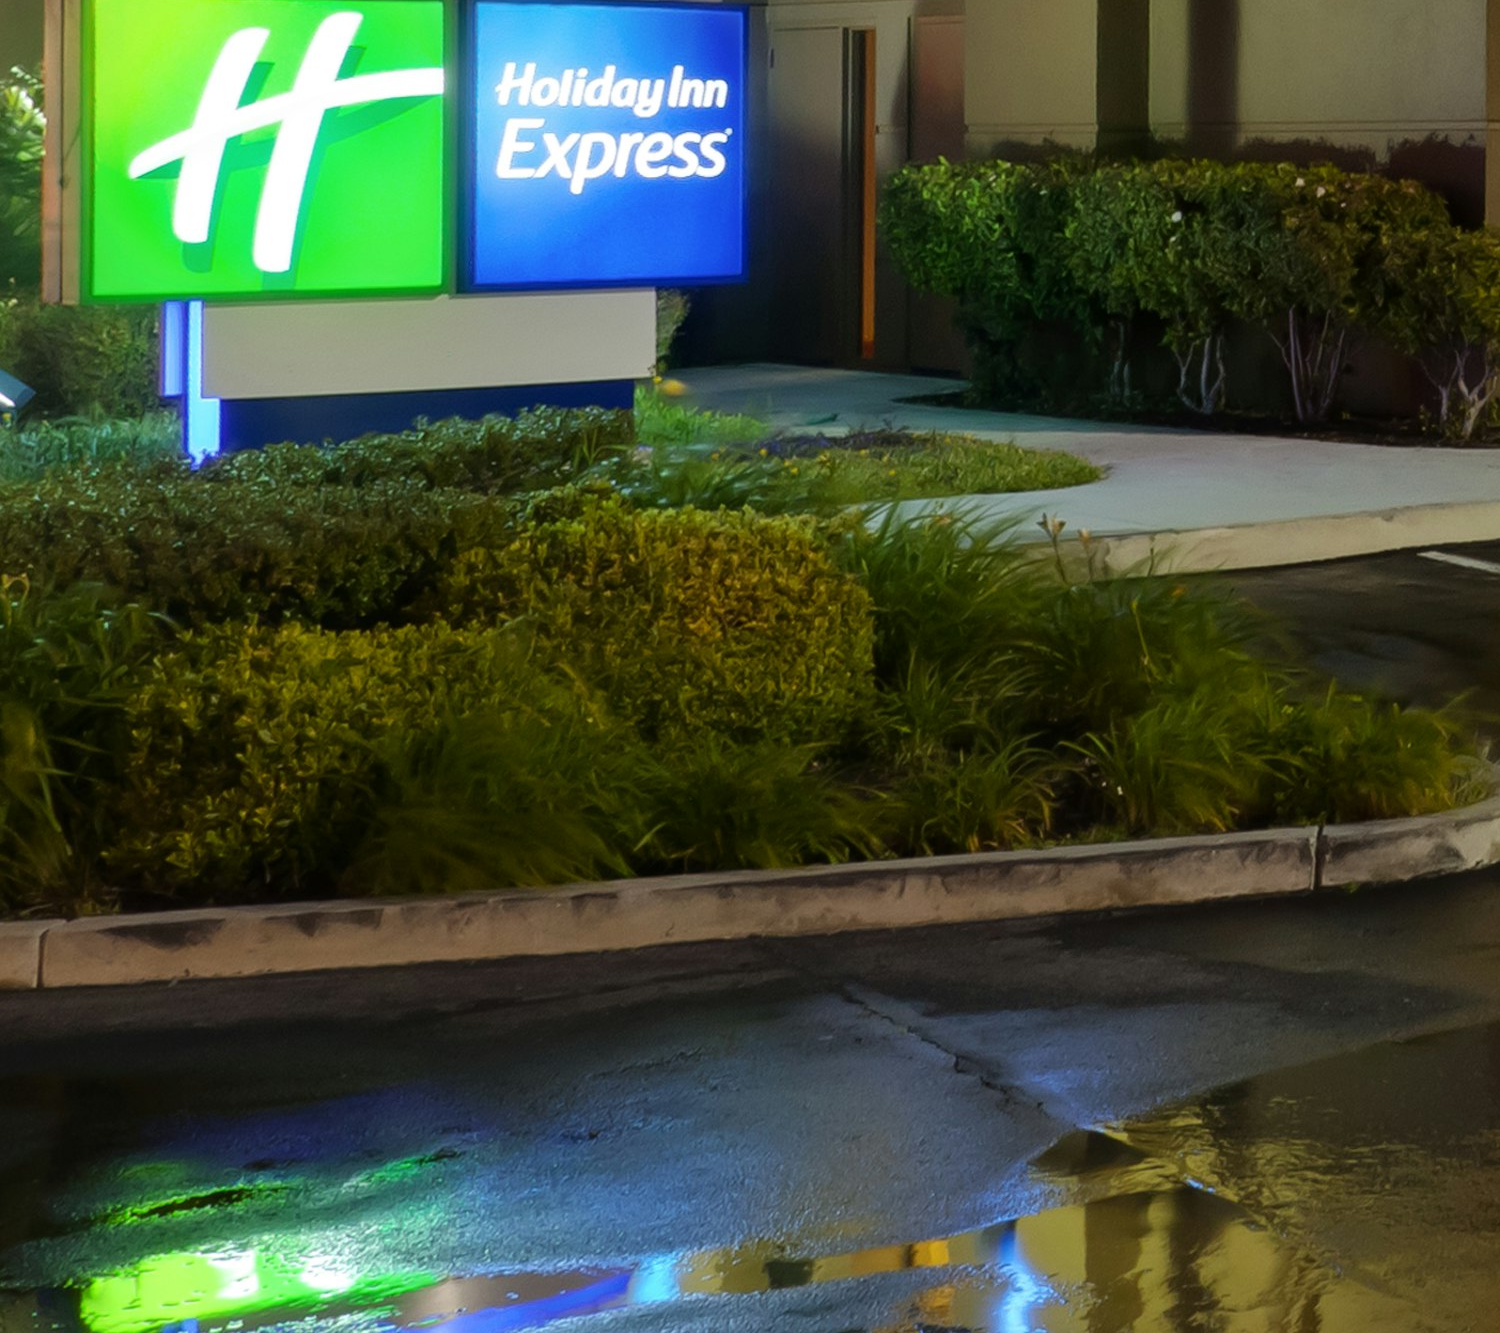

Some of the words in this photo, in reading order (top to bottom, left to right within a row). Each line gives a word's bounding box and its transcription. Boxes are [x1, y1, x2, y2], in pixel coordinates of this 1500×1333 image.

[495, 62, 665, 118] Holiday
[667, 65, 728, 108] Inn
[496, 118, 728, 195] Express
